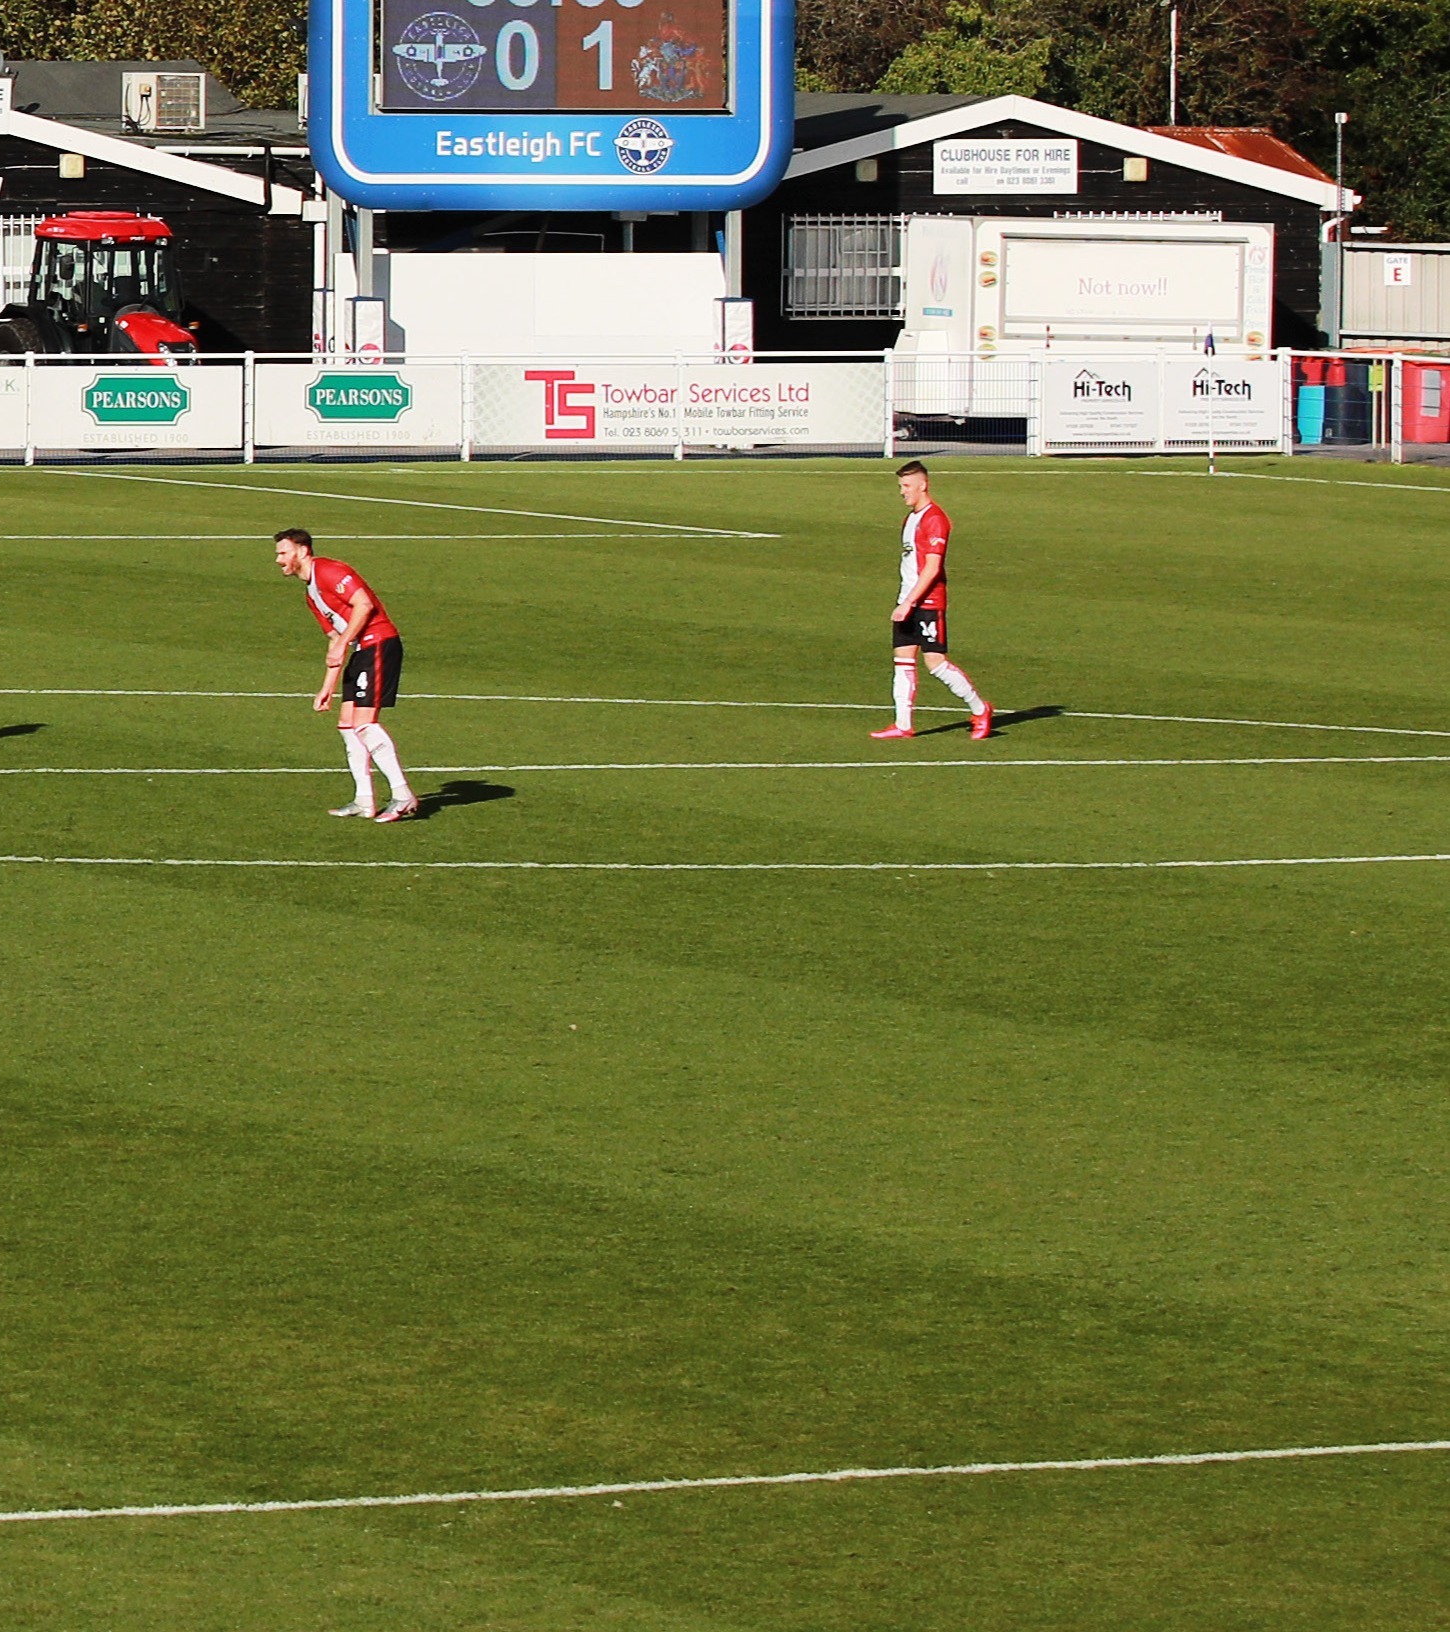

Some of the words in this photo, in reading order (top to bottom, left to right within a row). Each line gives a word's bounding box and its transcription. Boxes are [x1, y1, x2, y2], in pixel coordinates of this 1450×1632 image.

[496, 20, 540, 91] 0
[583, 20, 614, 91] 1
[436, 130, 562, 162] Eastleigh
[569, 131, 602, 156] FC
[941, 149, 1010, 162] CLUBHOUSE
[1016, 149, 1039, 161] FOR
[1044, 149, 1071, 161] HIRE
[1393, 267, 1402, 282] E
[1078, 277, 1113, 295] Not
[1118, 277, 1167, 295] now!!
[315, 388, 402, 406] PEARSONS
[602, 384, 678, 403] Towbar
[689, 383, 771, 403] Services
[779, 383, 809, 402] Ltd
[1073, 380, 1131, 402] Hi-Tech
[1192, 379, 1251, 400] Hi-Tech
[92, 391, 181, 408] PEARSONS
[658, 407, 676, 418] No.1
[684, 407, 713, 418] Mobile
[716, 407, 745, 418] Towbar
[749, 407, 775, 419] Fitting
[778, 406, 808, 417] Service
[83, 433, 158, 443] ESTABLISHED
[164, 433, 189, 443] 1900
[307, 431, 380, 441] ESTABLISHED
[386, 431, 410, 441] 1900
[623, 427, 641, 437] 023
[356, 671, 368, 690] 4
